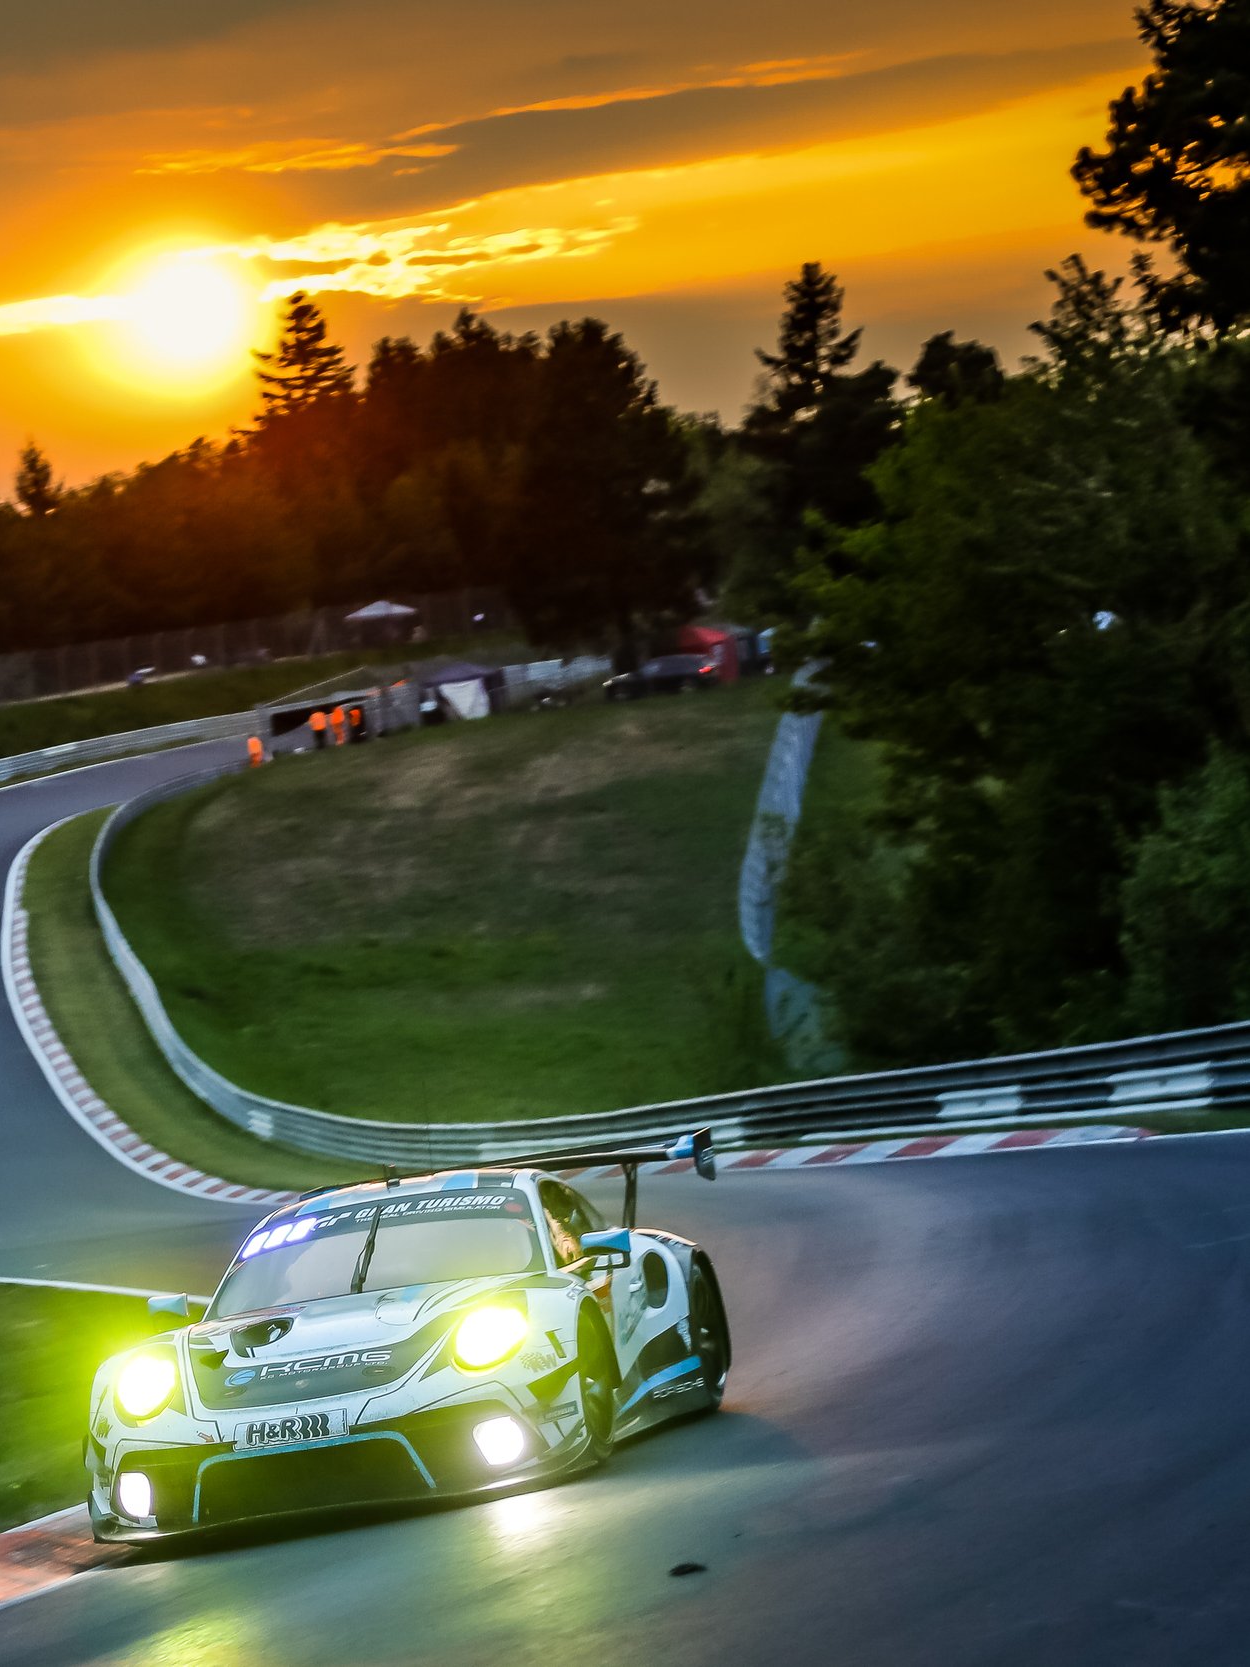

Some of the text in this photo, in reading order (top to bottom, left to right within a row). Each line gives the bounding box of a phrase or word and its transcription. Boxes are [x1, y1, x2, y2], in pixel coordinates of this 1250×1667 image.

[402, 1207, 442, 1216] DRIVING
[415, 1195, 507, 1210] TURISMO
[654, 1377, 704, 1398] PORSCHE
[246, 1417, 300, 1446] H&R
